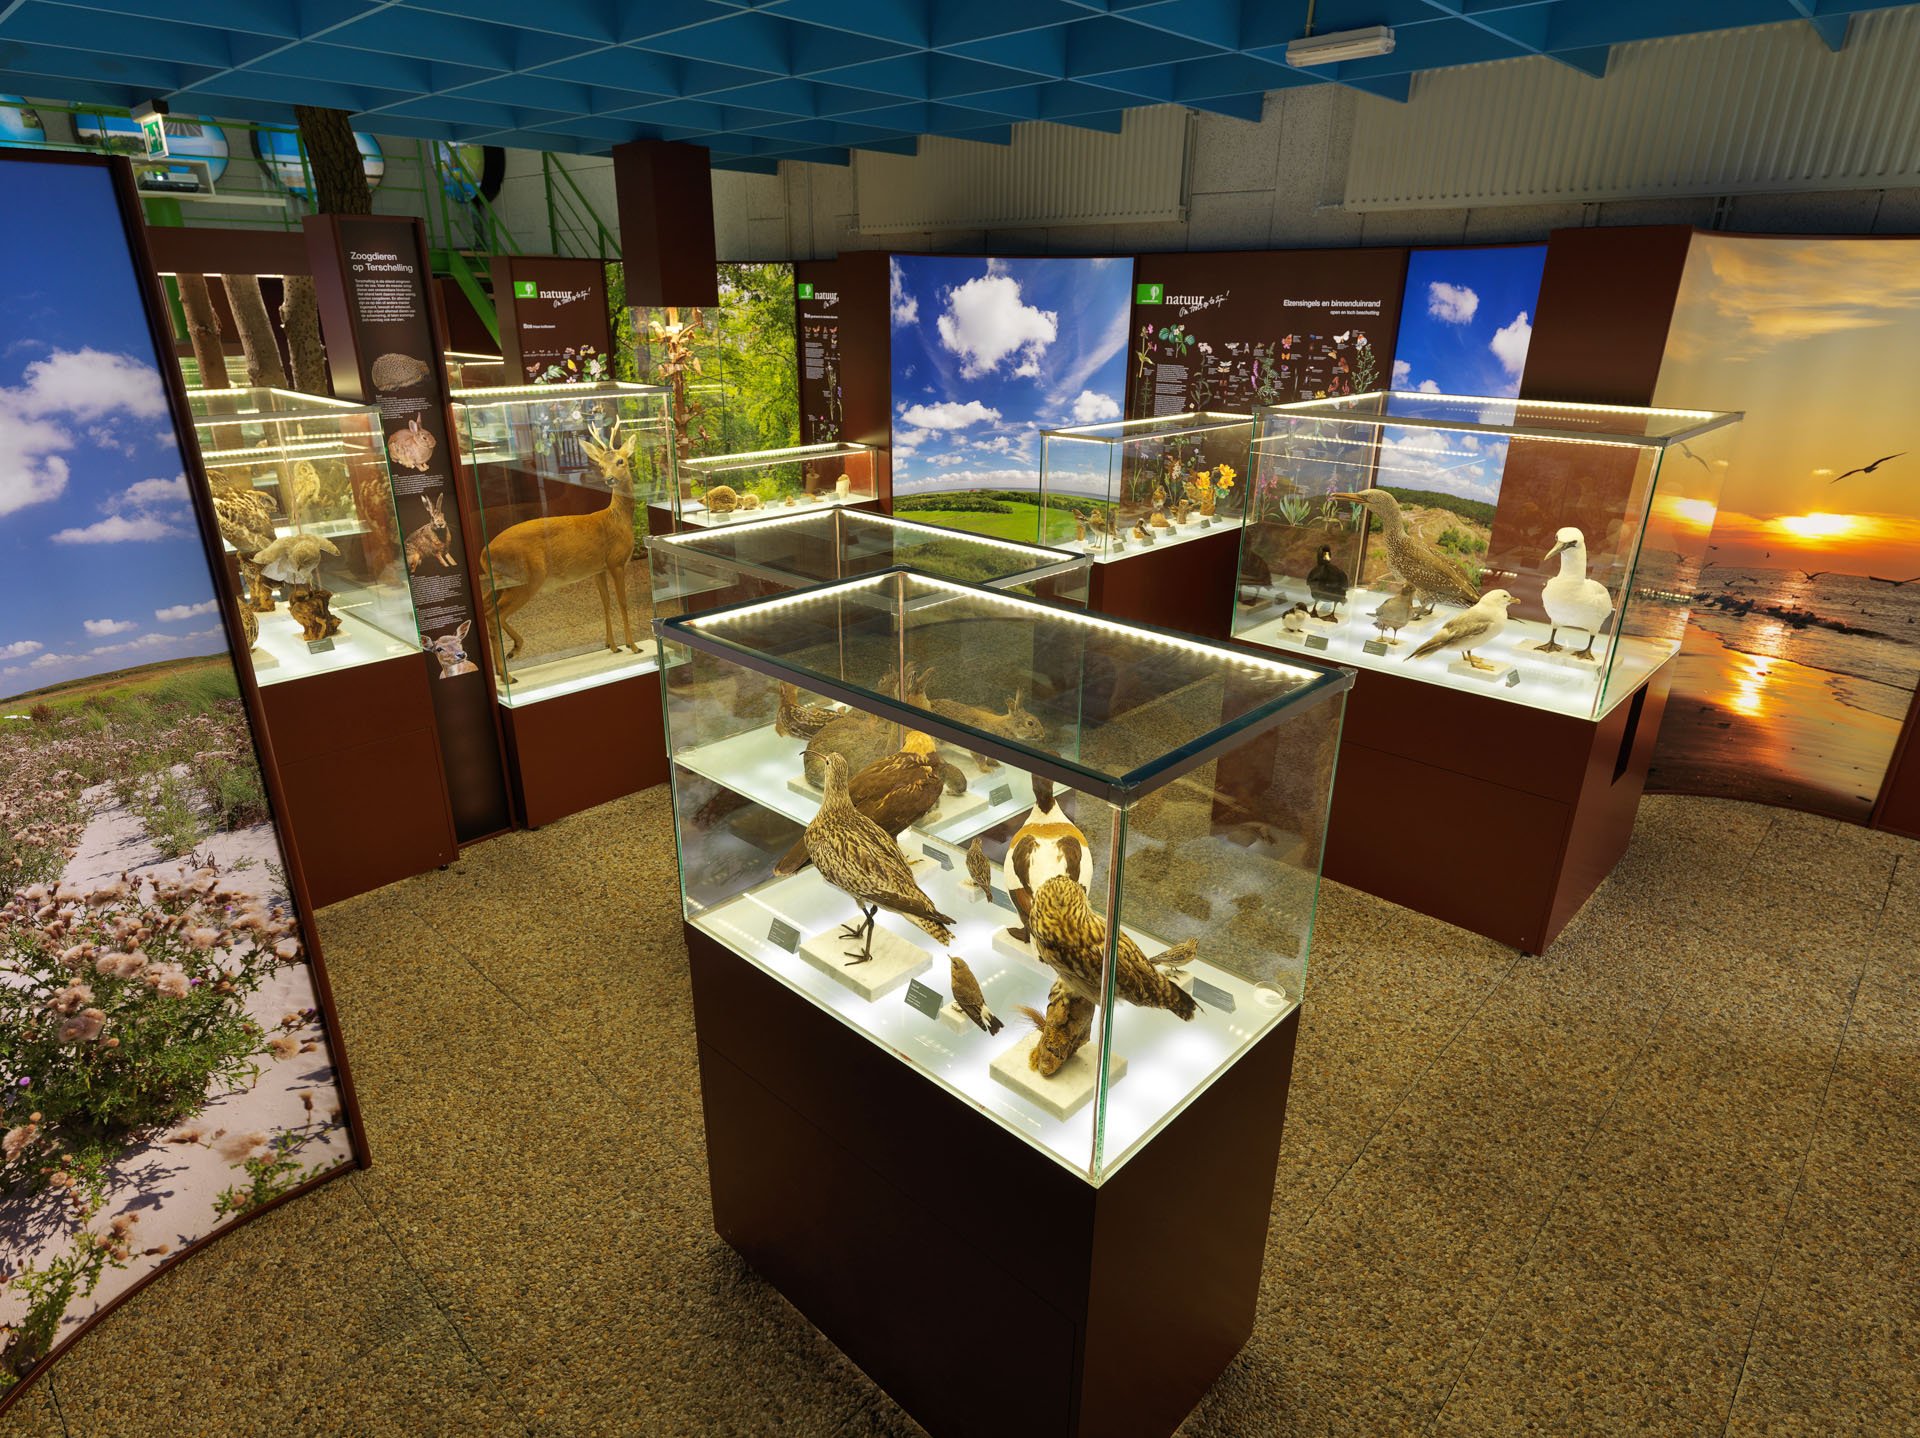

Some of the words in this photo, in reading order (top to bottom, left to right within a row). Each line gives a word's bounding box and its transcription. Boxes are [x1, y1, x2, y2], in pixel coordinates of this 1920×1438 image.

[350, 251, 397, 261] Zoogdieren
[352, 264, 364, 272] op
[365, 263, 413, 273] Terschelling
[540, 290, 572, 299] natuur
[1165, 295, 1204, 305] natuur
[1283, 299, 1320, 308] Elzensingels
[1331, 299, 1381, 308] binnenduinrand
